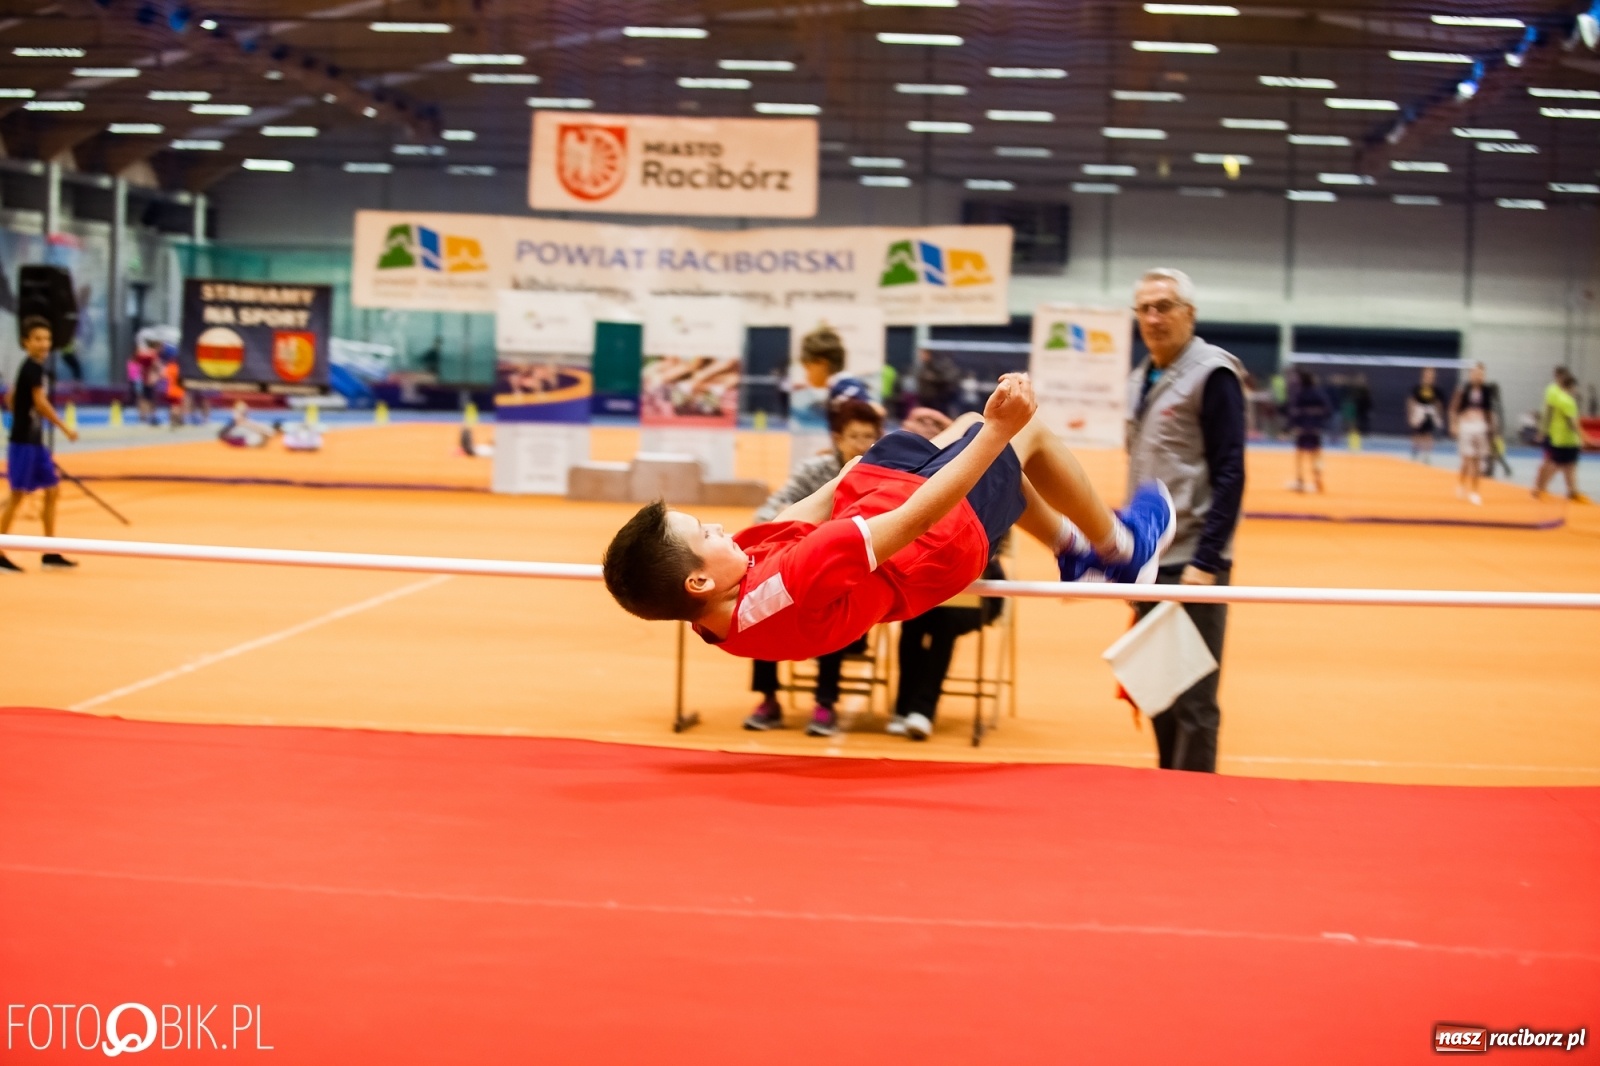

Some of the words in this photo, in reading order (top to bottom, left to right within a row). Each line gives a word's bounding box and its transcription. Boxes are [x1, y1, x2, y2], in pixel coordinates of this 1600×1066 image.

[643, 141, 724, 157] MIASTO
[641, 160, 791, 191] Racibórz
[516, 240, 647, 271] POWIAT
[657, 246, 855, 274] RACIBORSKI
[203, 306, 236, 324] NA
[239, 308, 310, 329] SPORT
